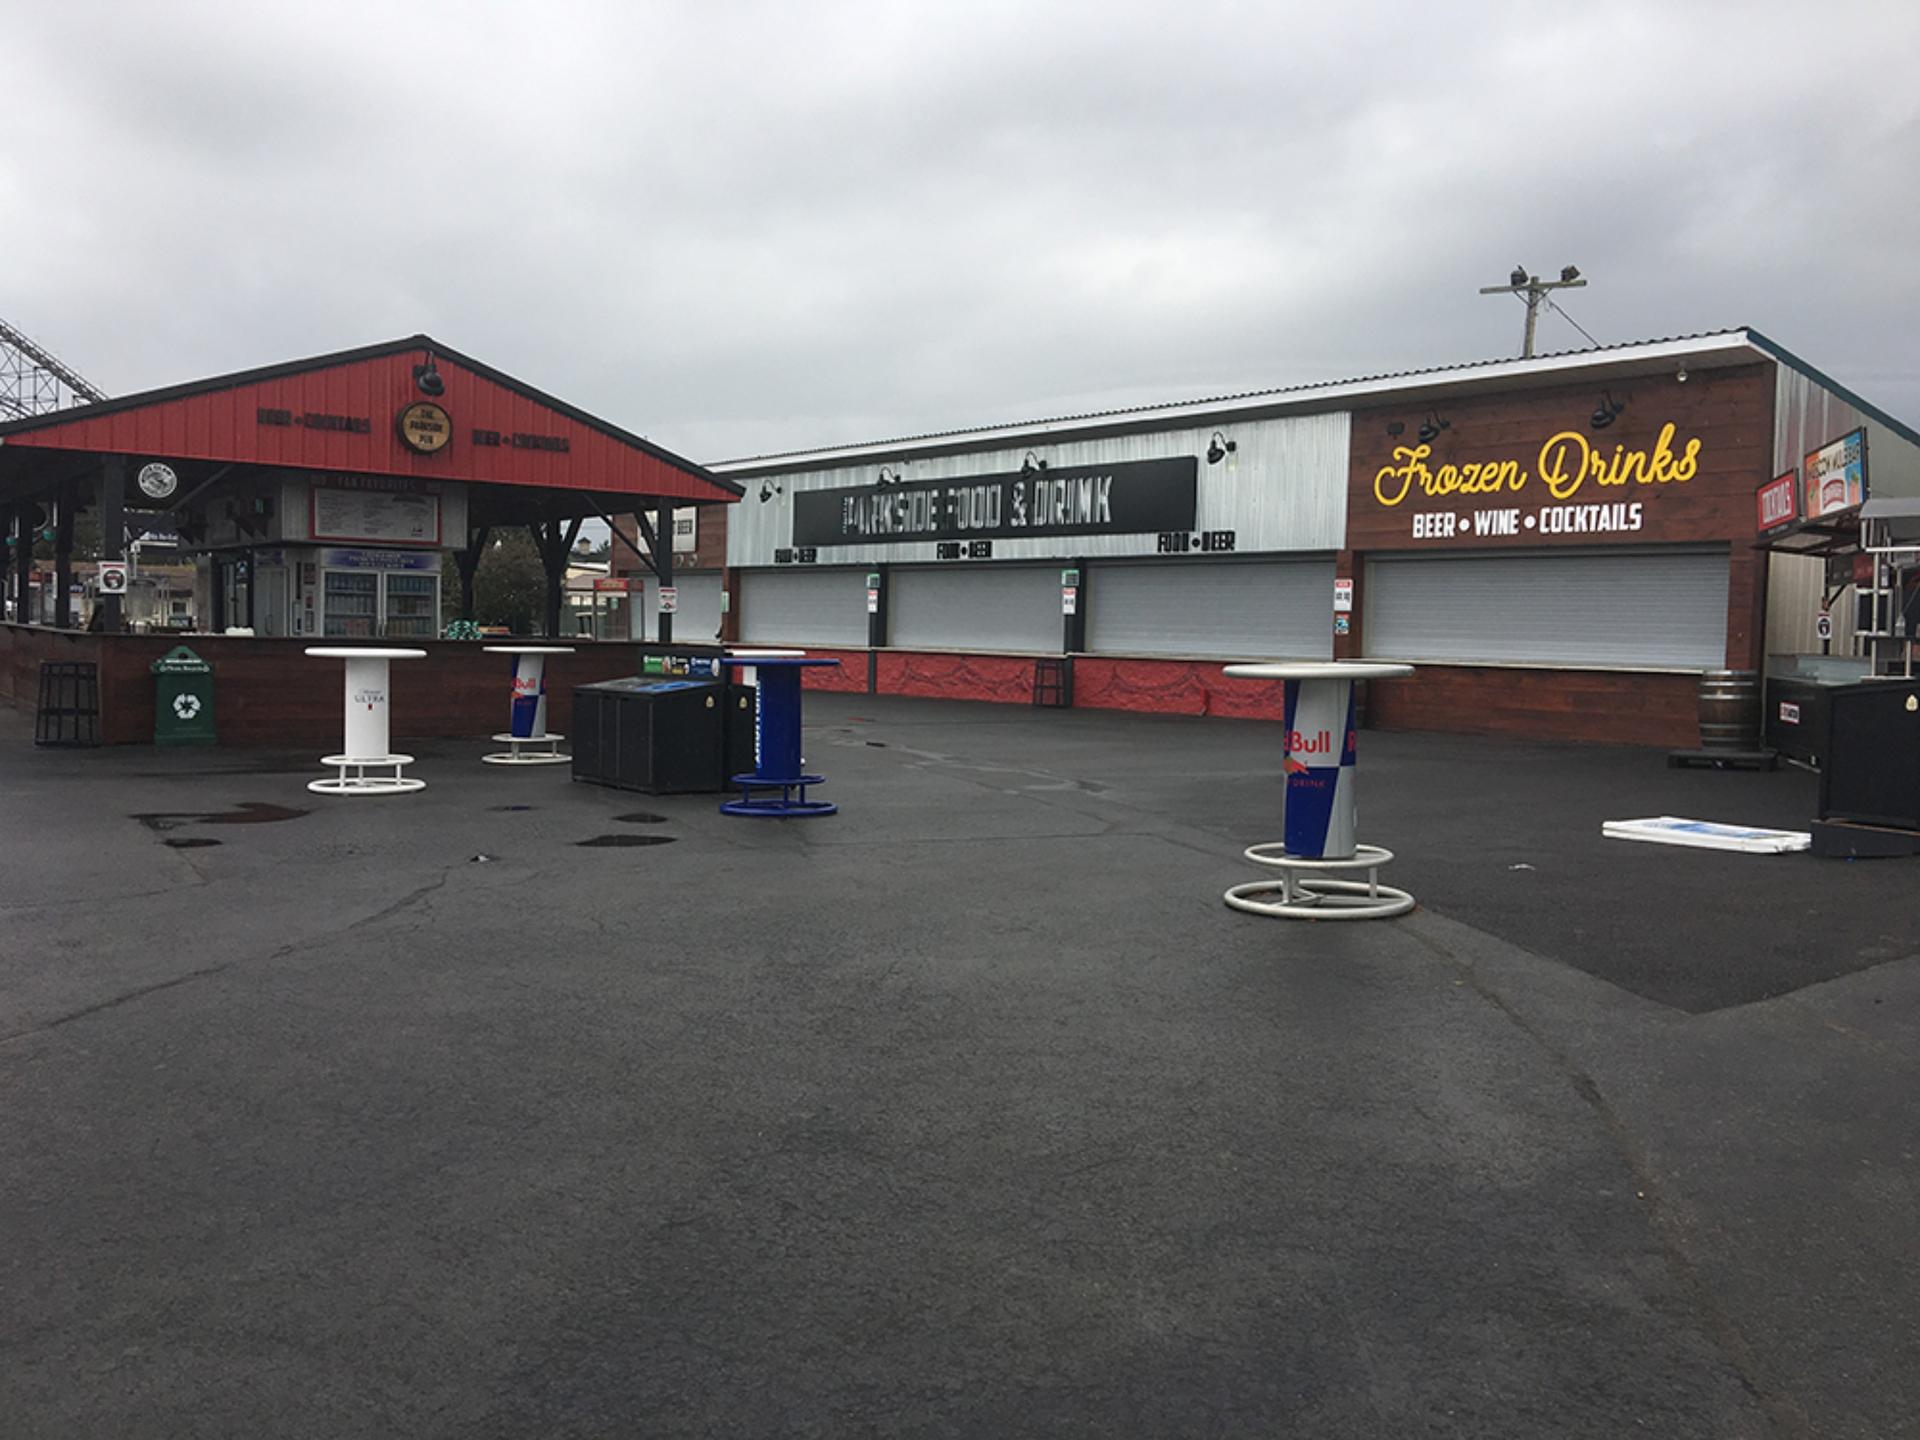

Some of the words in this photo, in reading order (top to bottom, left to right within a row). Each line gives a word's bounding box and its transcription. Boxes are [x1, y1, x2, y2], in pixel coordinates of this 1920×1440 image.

[1374, 443, 1528, 506] Frozen
[1538, 421, 1702, 500] Drinks
[842, 489, 938, 535] PARKSIDE
[946, 484, 1002, 531] FOOD
[1009, 481, 1027, 527] &
[1033, 475, 1113, 527] DRINK
[1412, 511, 1455, 538] BEER
[1473, 508, 1520, 536] WINE
[1539, 502, 1643, 533] COCKTAILS
[1201, 529, 1235, 551] BEER
[1290, 730, 1331, 753] Bull
